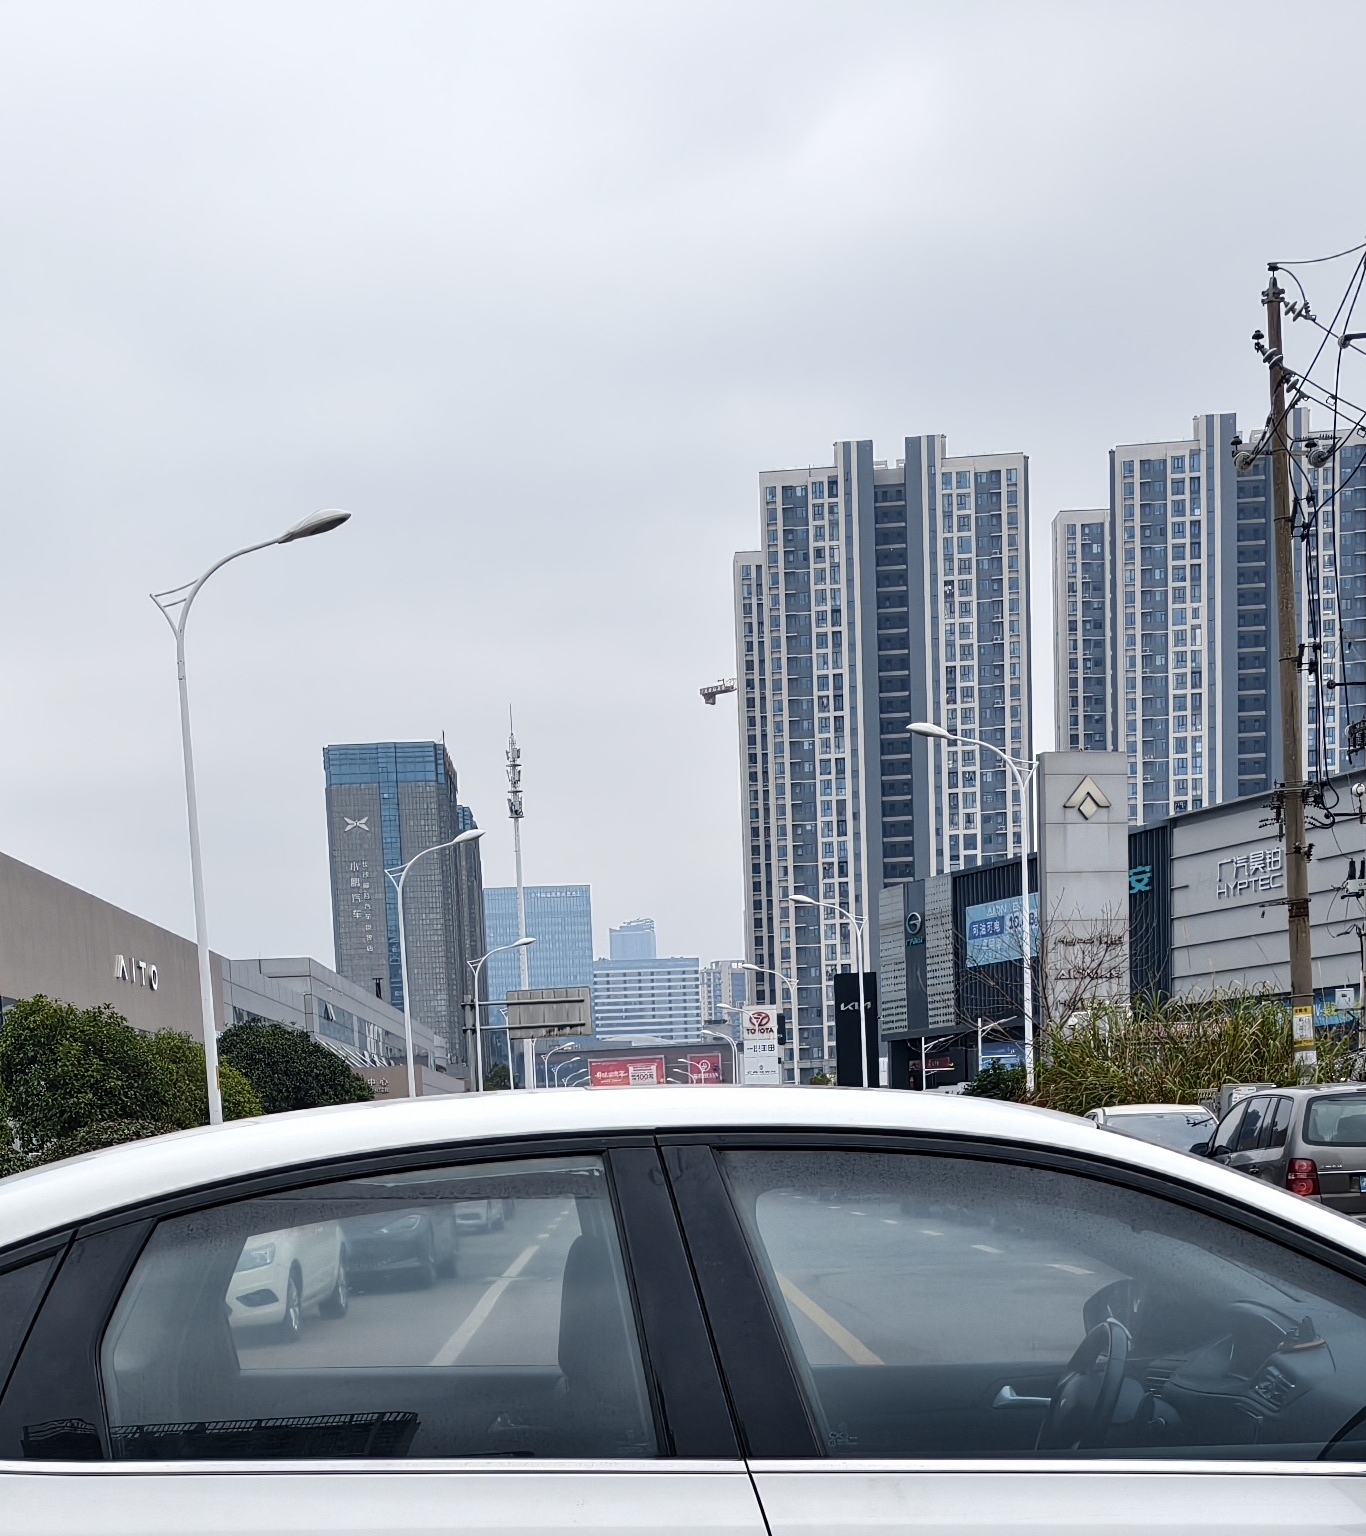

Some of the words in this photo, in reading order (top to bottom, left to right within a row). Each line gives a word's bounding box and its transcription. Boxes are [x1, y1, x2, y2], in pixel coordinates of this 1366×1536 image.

[1129, 865, 1152, 894] 安
[1217, 847, 1281, 883] 广汽昊铂
[1217, 873, 1283, 899] HYPTEC
[114, 954, 159, 991] AITO
